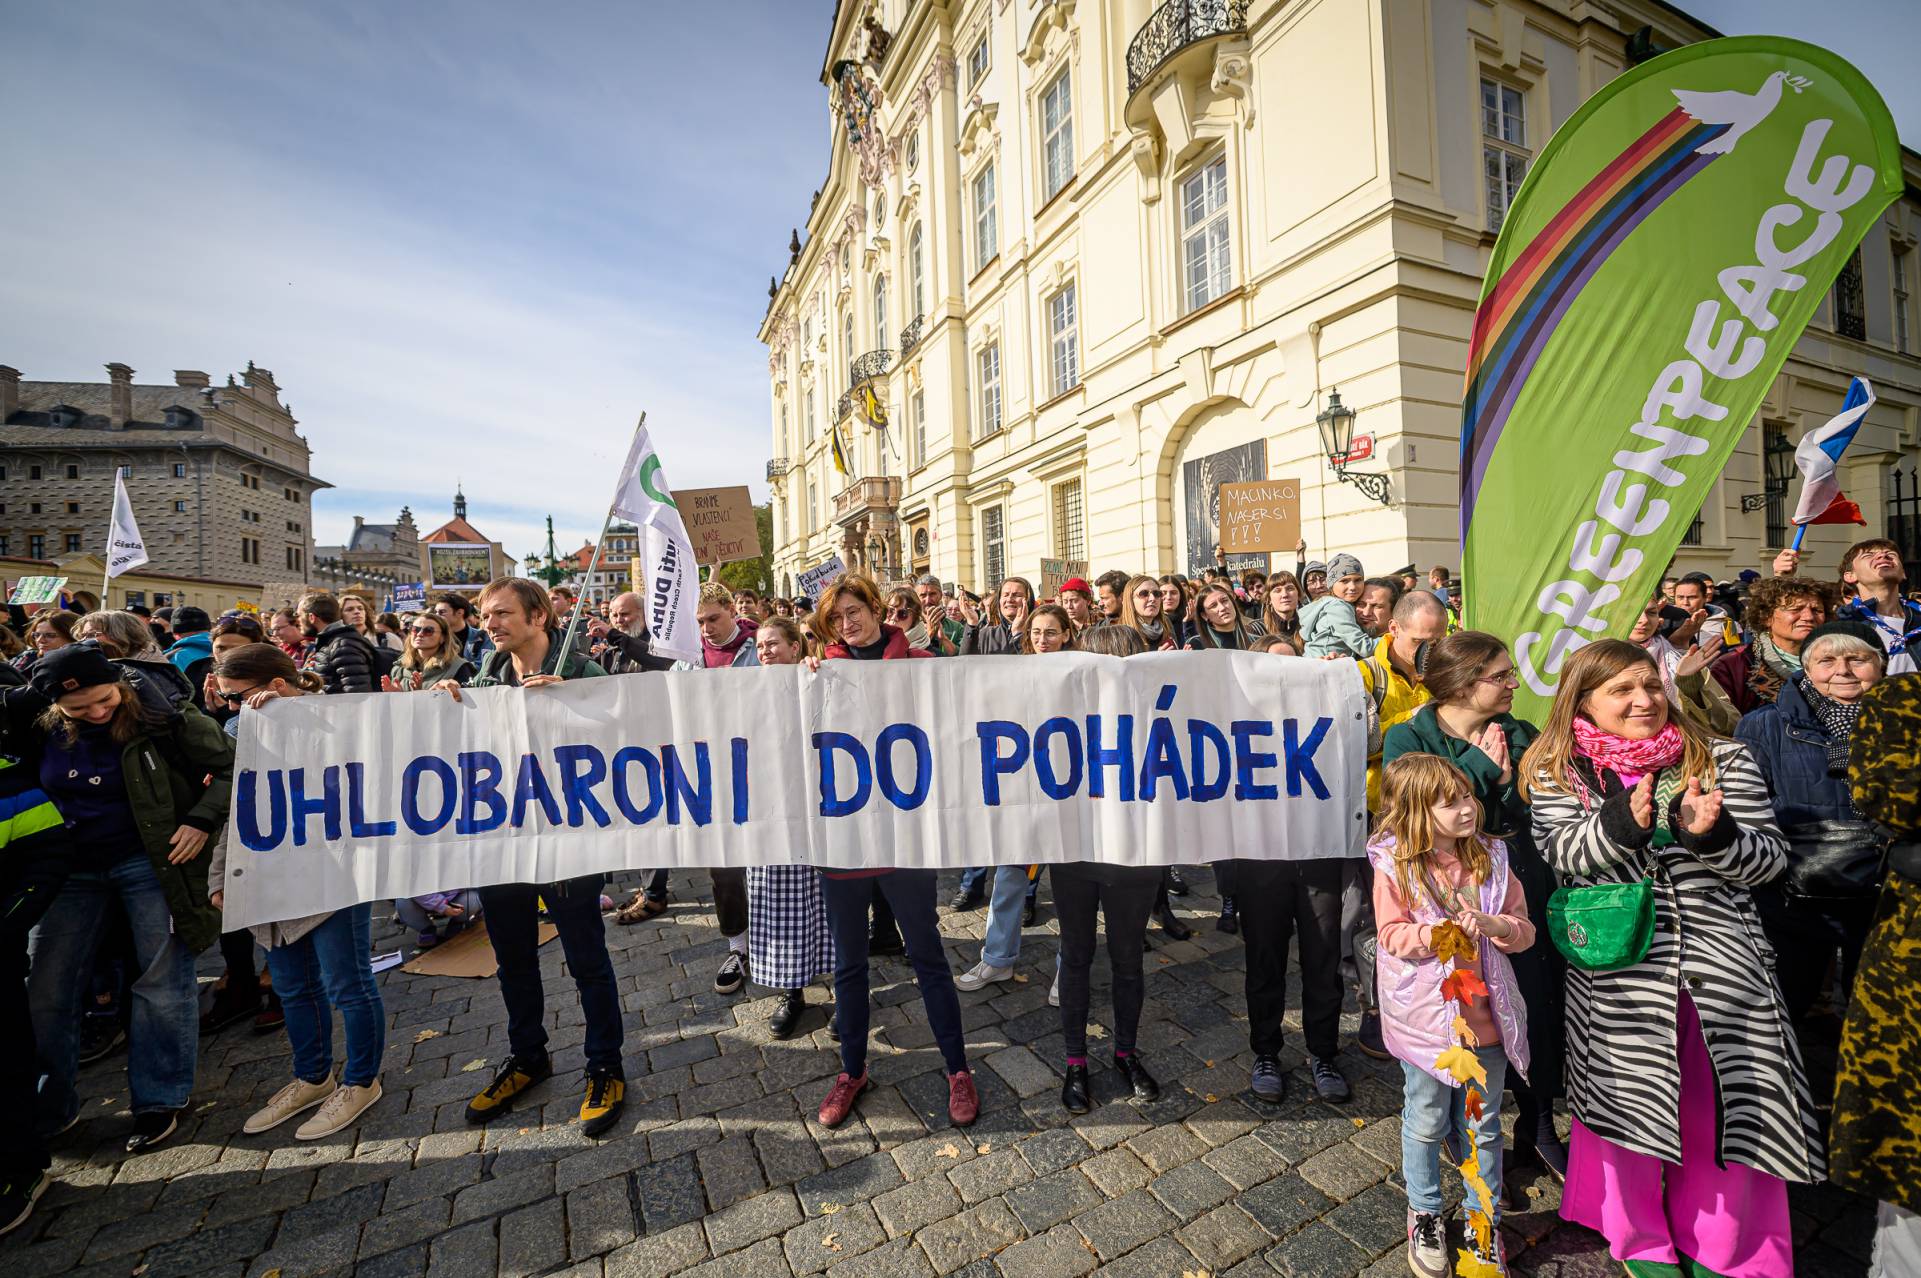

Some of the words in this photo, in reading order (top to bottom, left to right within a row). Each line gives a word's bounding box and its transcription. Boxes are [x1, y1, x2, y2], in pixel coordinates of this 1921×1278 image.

[1514, 118, 1876, 697] GREENPEACE
[1227, 508, 1273, 526] NASER
[1273, 507, 1288, 520] SI
[1227, 557, 1265, 571] katedrálu
[236, 737, 749, 851] UHLOBARONI
[812, 723, 932, 817] DO
[976, 684, 1333, 806] POHÁDEK
